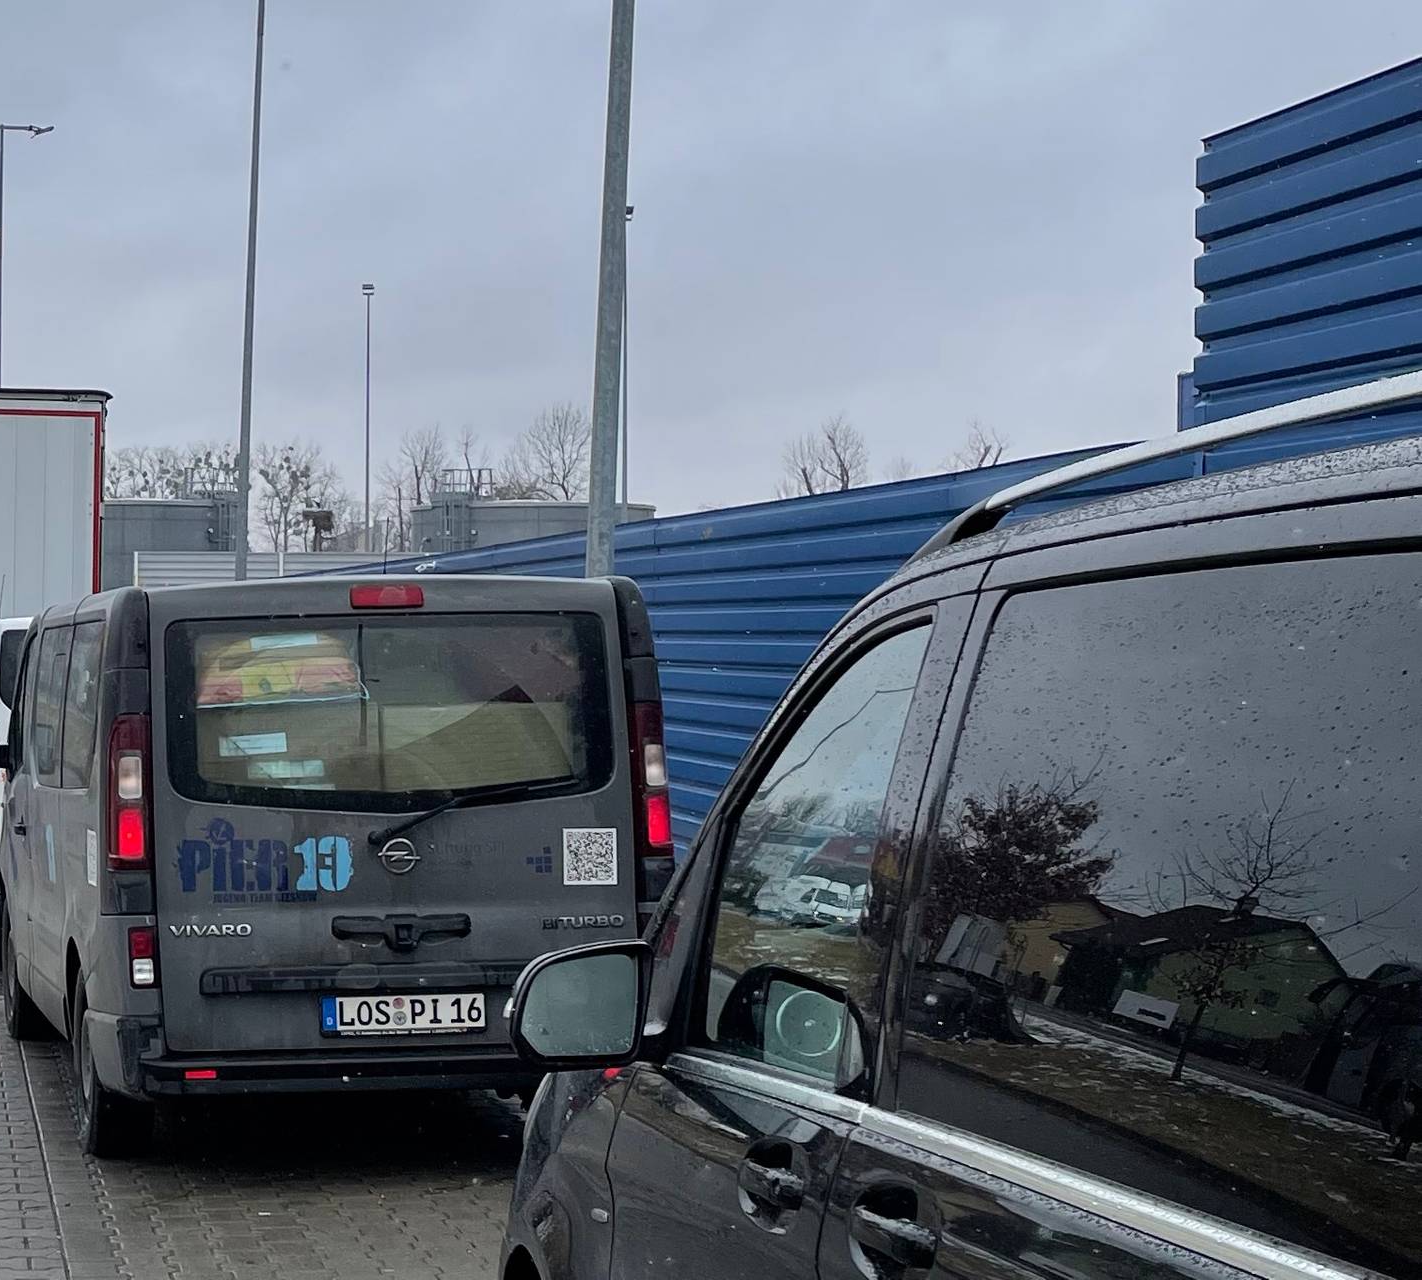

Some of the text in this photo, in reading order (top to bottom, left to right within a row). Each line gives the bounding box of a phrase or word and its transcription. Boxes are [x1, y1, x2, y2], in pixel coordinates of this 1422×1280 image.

[293, 836, 354, 891] 13
[168, 923, 253, 938] VIVARO
[542, 914, 624, 930] BITURBO
[338, 999, 390, 1027] LOS
